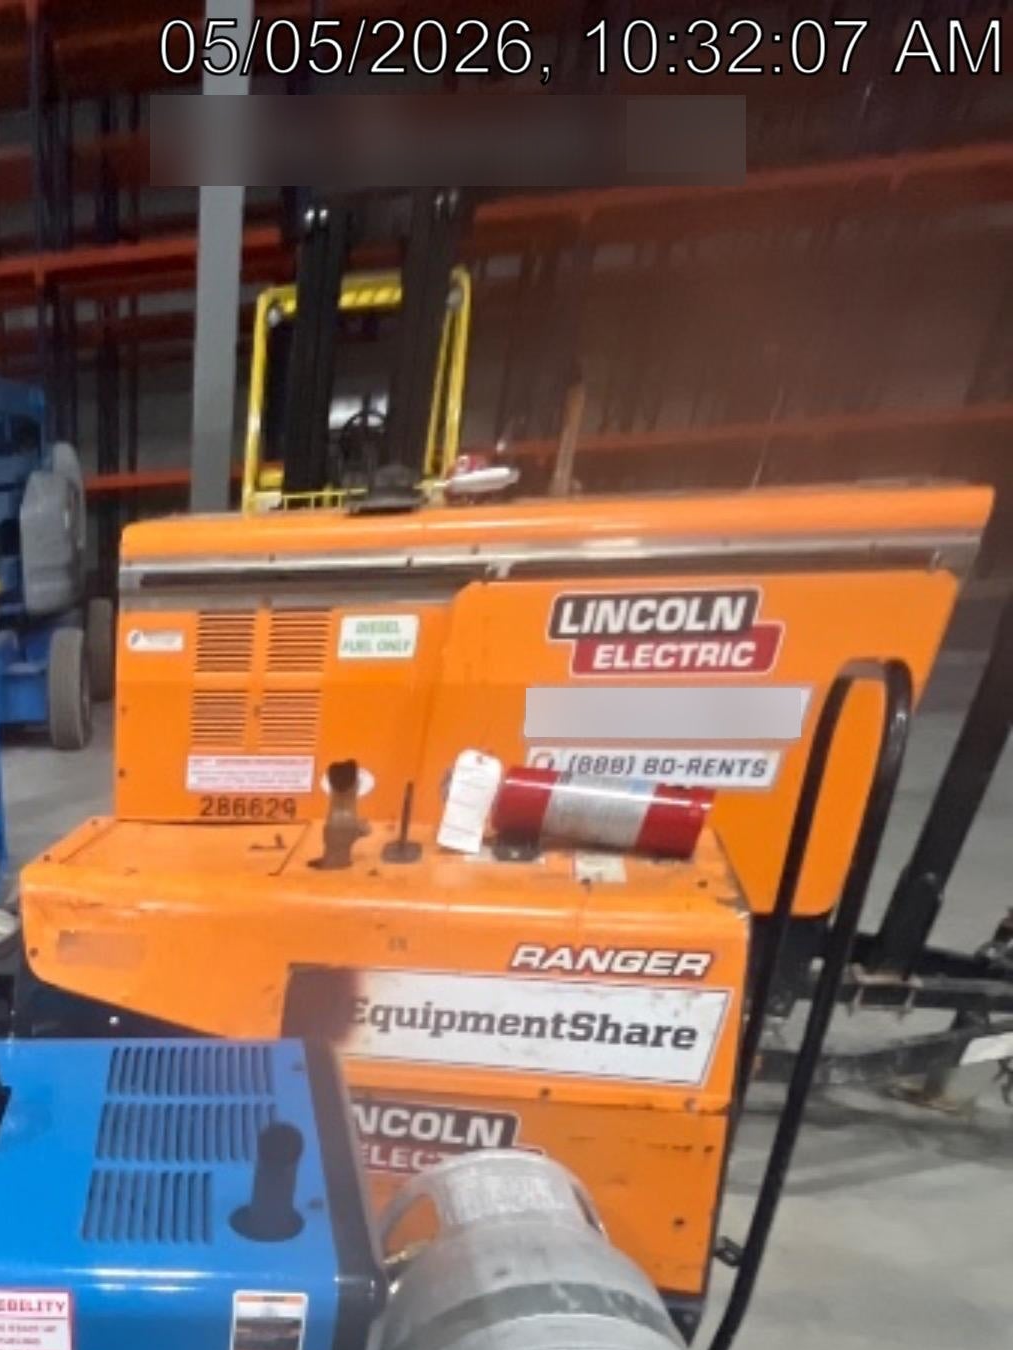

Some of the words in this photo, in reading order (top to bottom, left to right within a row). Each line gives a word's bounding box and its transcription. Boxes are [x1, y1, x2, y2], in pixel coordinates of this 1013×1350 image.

[558, 597, 748, 635] LINCOLN
[592, 642, 756, 670] ELECTRIC
[568, 755, 636, 776] (888)
[200, 795, 297, 818] 286629
[510, 945, 713, 977] RANGER
